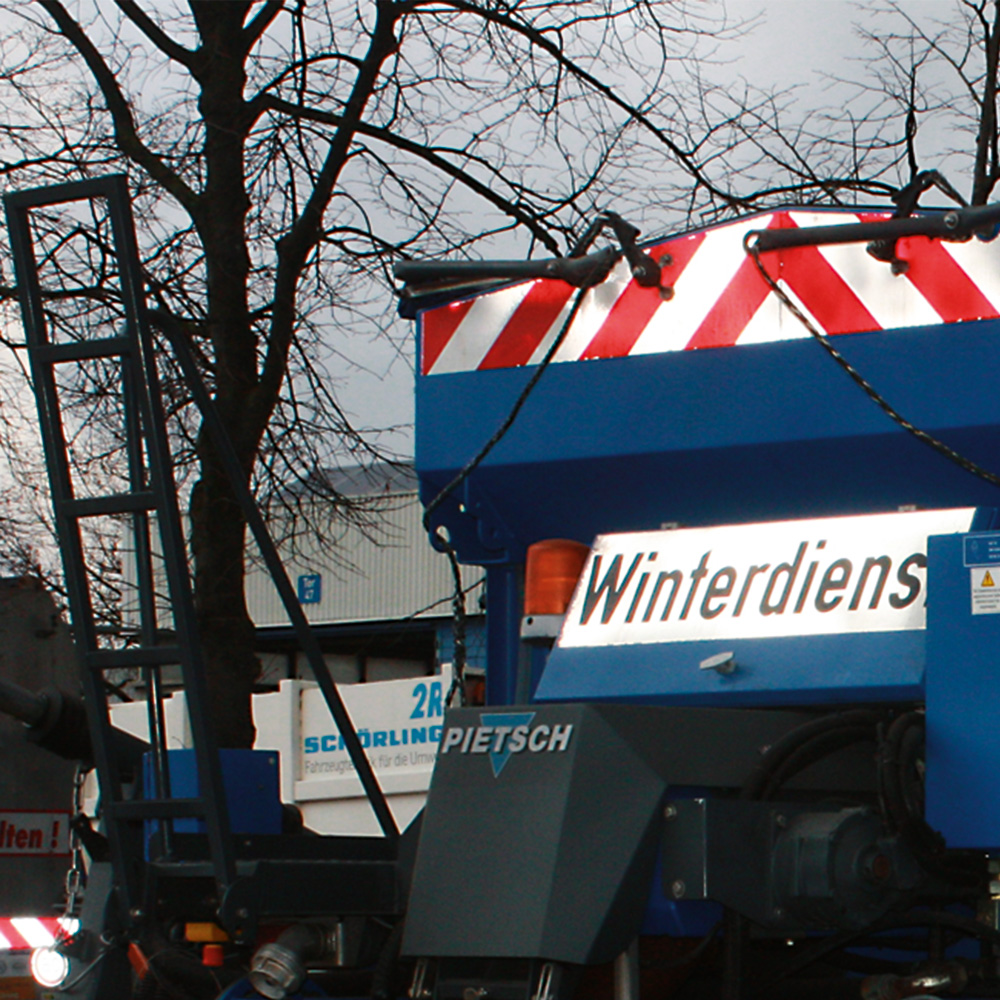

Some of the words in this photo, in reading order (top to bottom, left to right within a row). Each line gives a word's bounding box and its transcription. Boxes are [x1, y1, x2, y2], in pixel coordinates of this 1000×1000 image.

[579, 540, 928, 626] Winterdiens
[441, 723, 574, 754] PIETSCH
[379, 756, 393, 768] für
[394, 753, 408, 767] die
